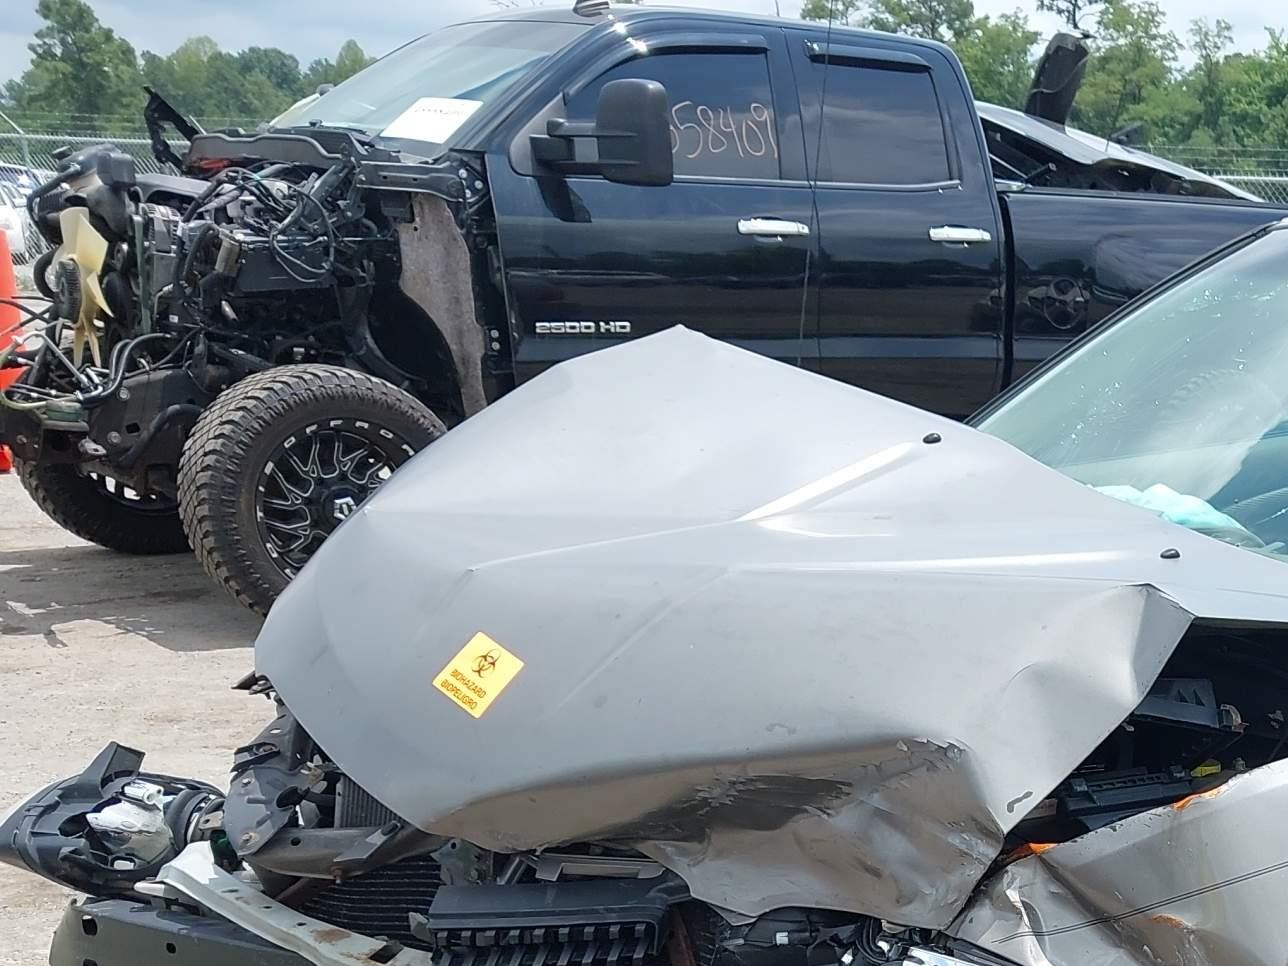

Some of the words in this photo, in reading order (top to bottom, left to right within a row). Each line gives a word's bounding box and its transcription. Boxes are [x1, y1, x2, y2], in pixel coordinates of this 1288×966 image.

[535, 321, 596, 333] 2500
[599, 321, 631, 333] HD
[440, 679, 478, 710] BIOPELIGRO
[451, 669, 487, 699] BIOHAZARD
